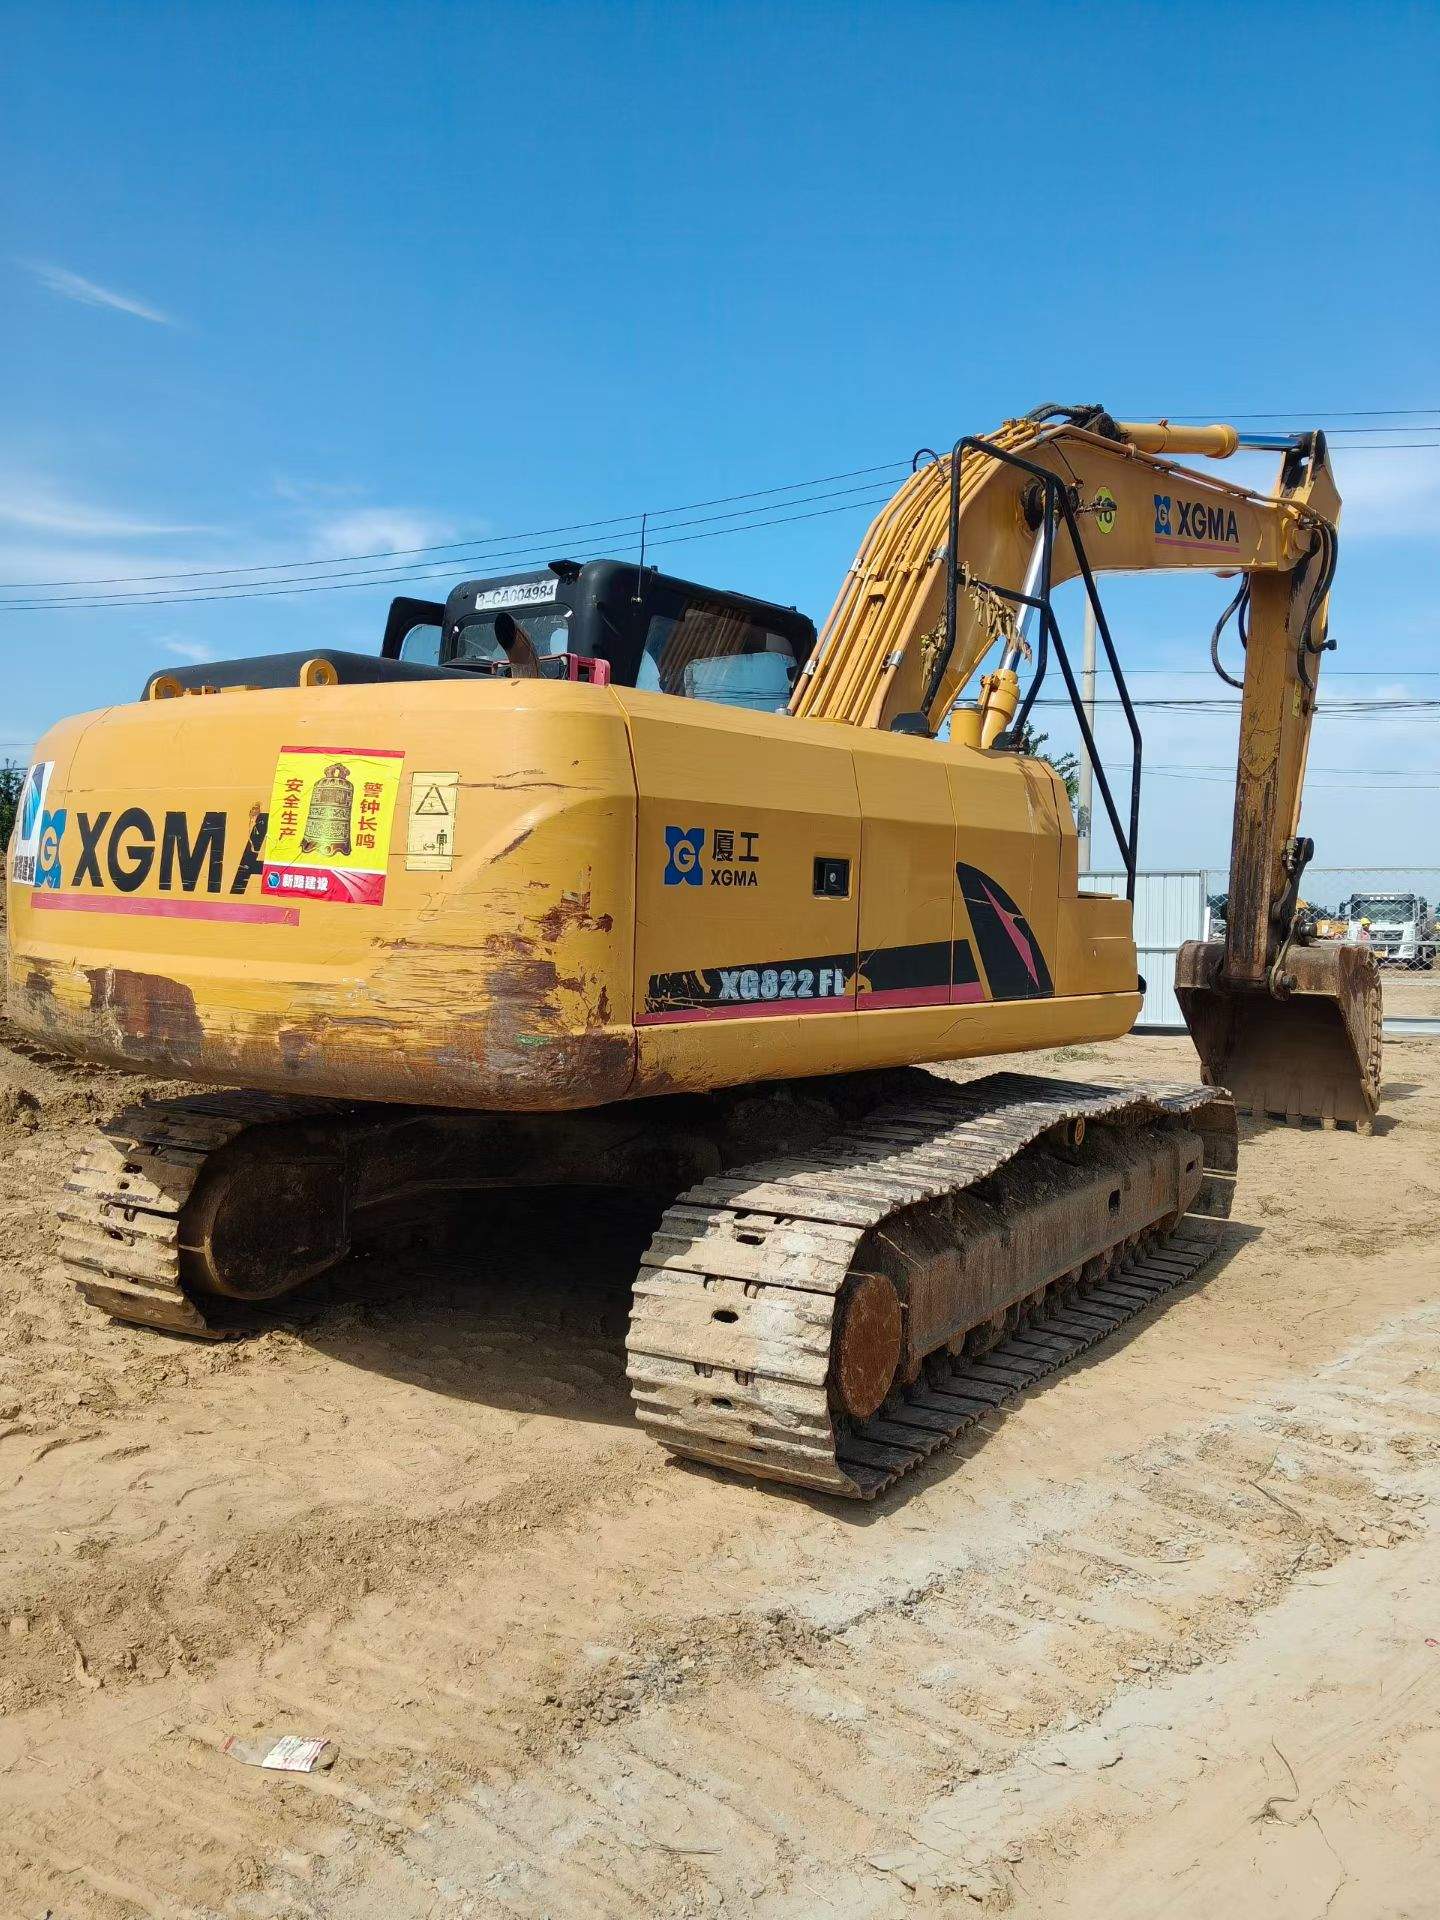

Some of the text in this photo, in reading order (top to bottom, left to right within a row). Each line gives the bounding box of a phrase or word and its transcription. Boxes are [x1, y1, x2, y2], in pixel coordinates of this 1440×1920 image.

[1177, 500, 1239, 543] XGMA
[279, 778, 304, 841] 安全生产
[356, 782, 383, 849] 警钟长鸣
[712, 829, 759, 862] 厦工
[711, 869, 758, 886] XGMA
